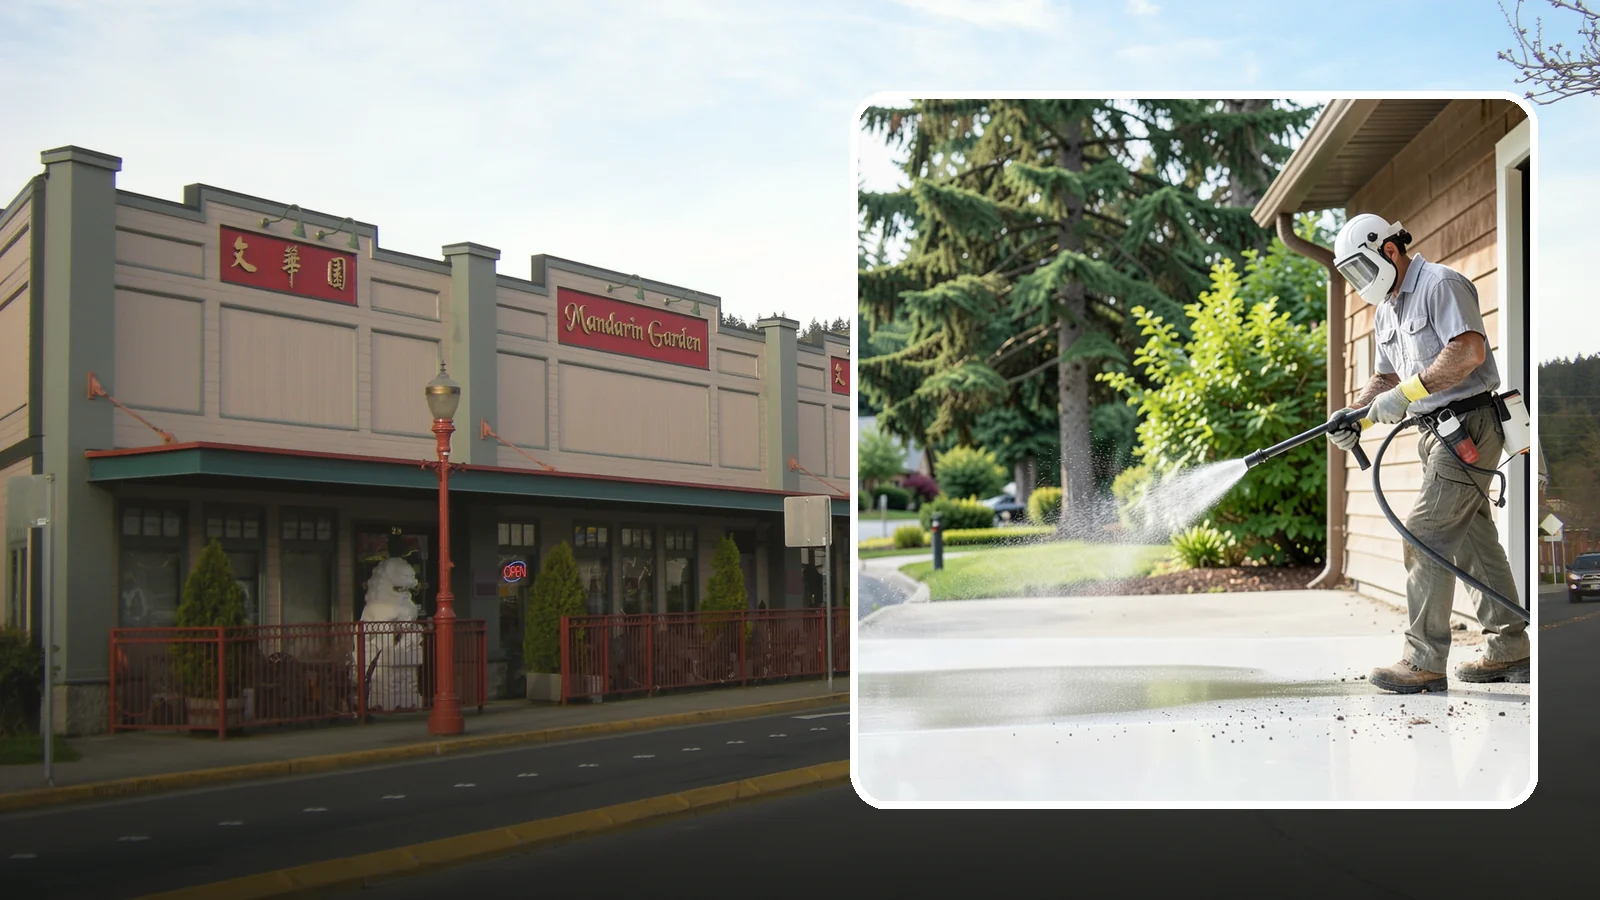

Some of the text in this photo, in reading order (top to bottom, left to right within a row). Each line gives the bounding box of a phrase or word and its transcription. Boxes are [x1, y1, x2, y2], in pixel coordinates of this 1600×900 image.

[565, 302, 702, 352] Mandarin Garden
[503, 565, 526, 578] OPEN
